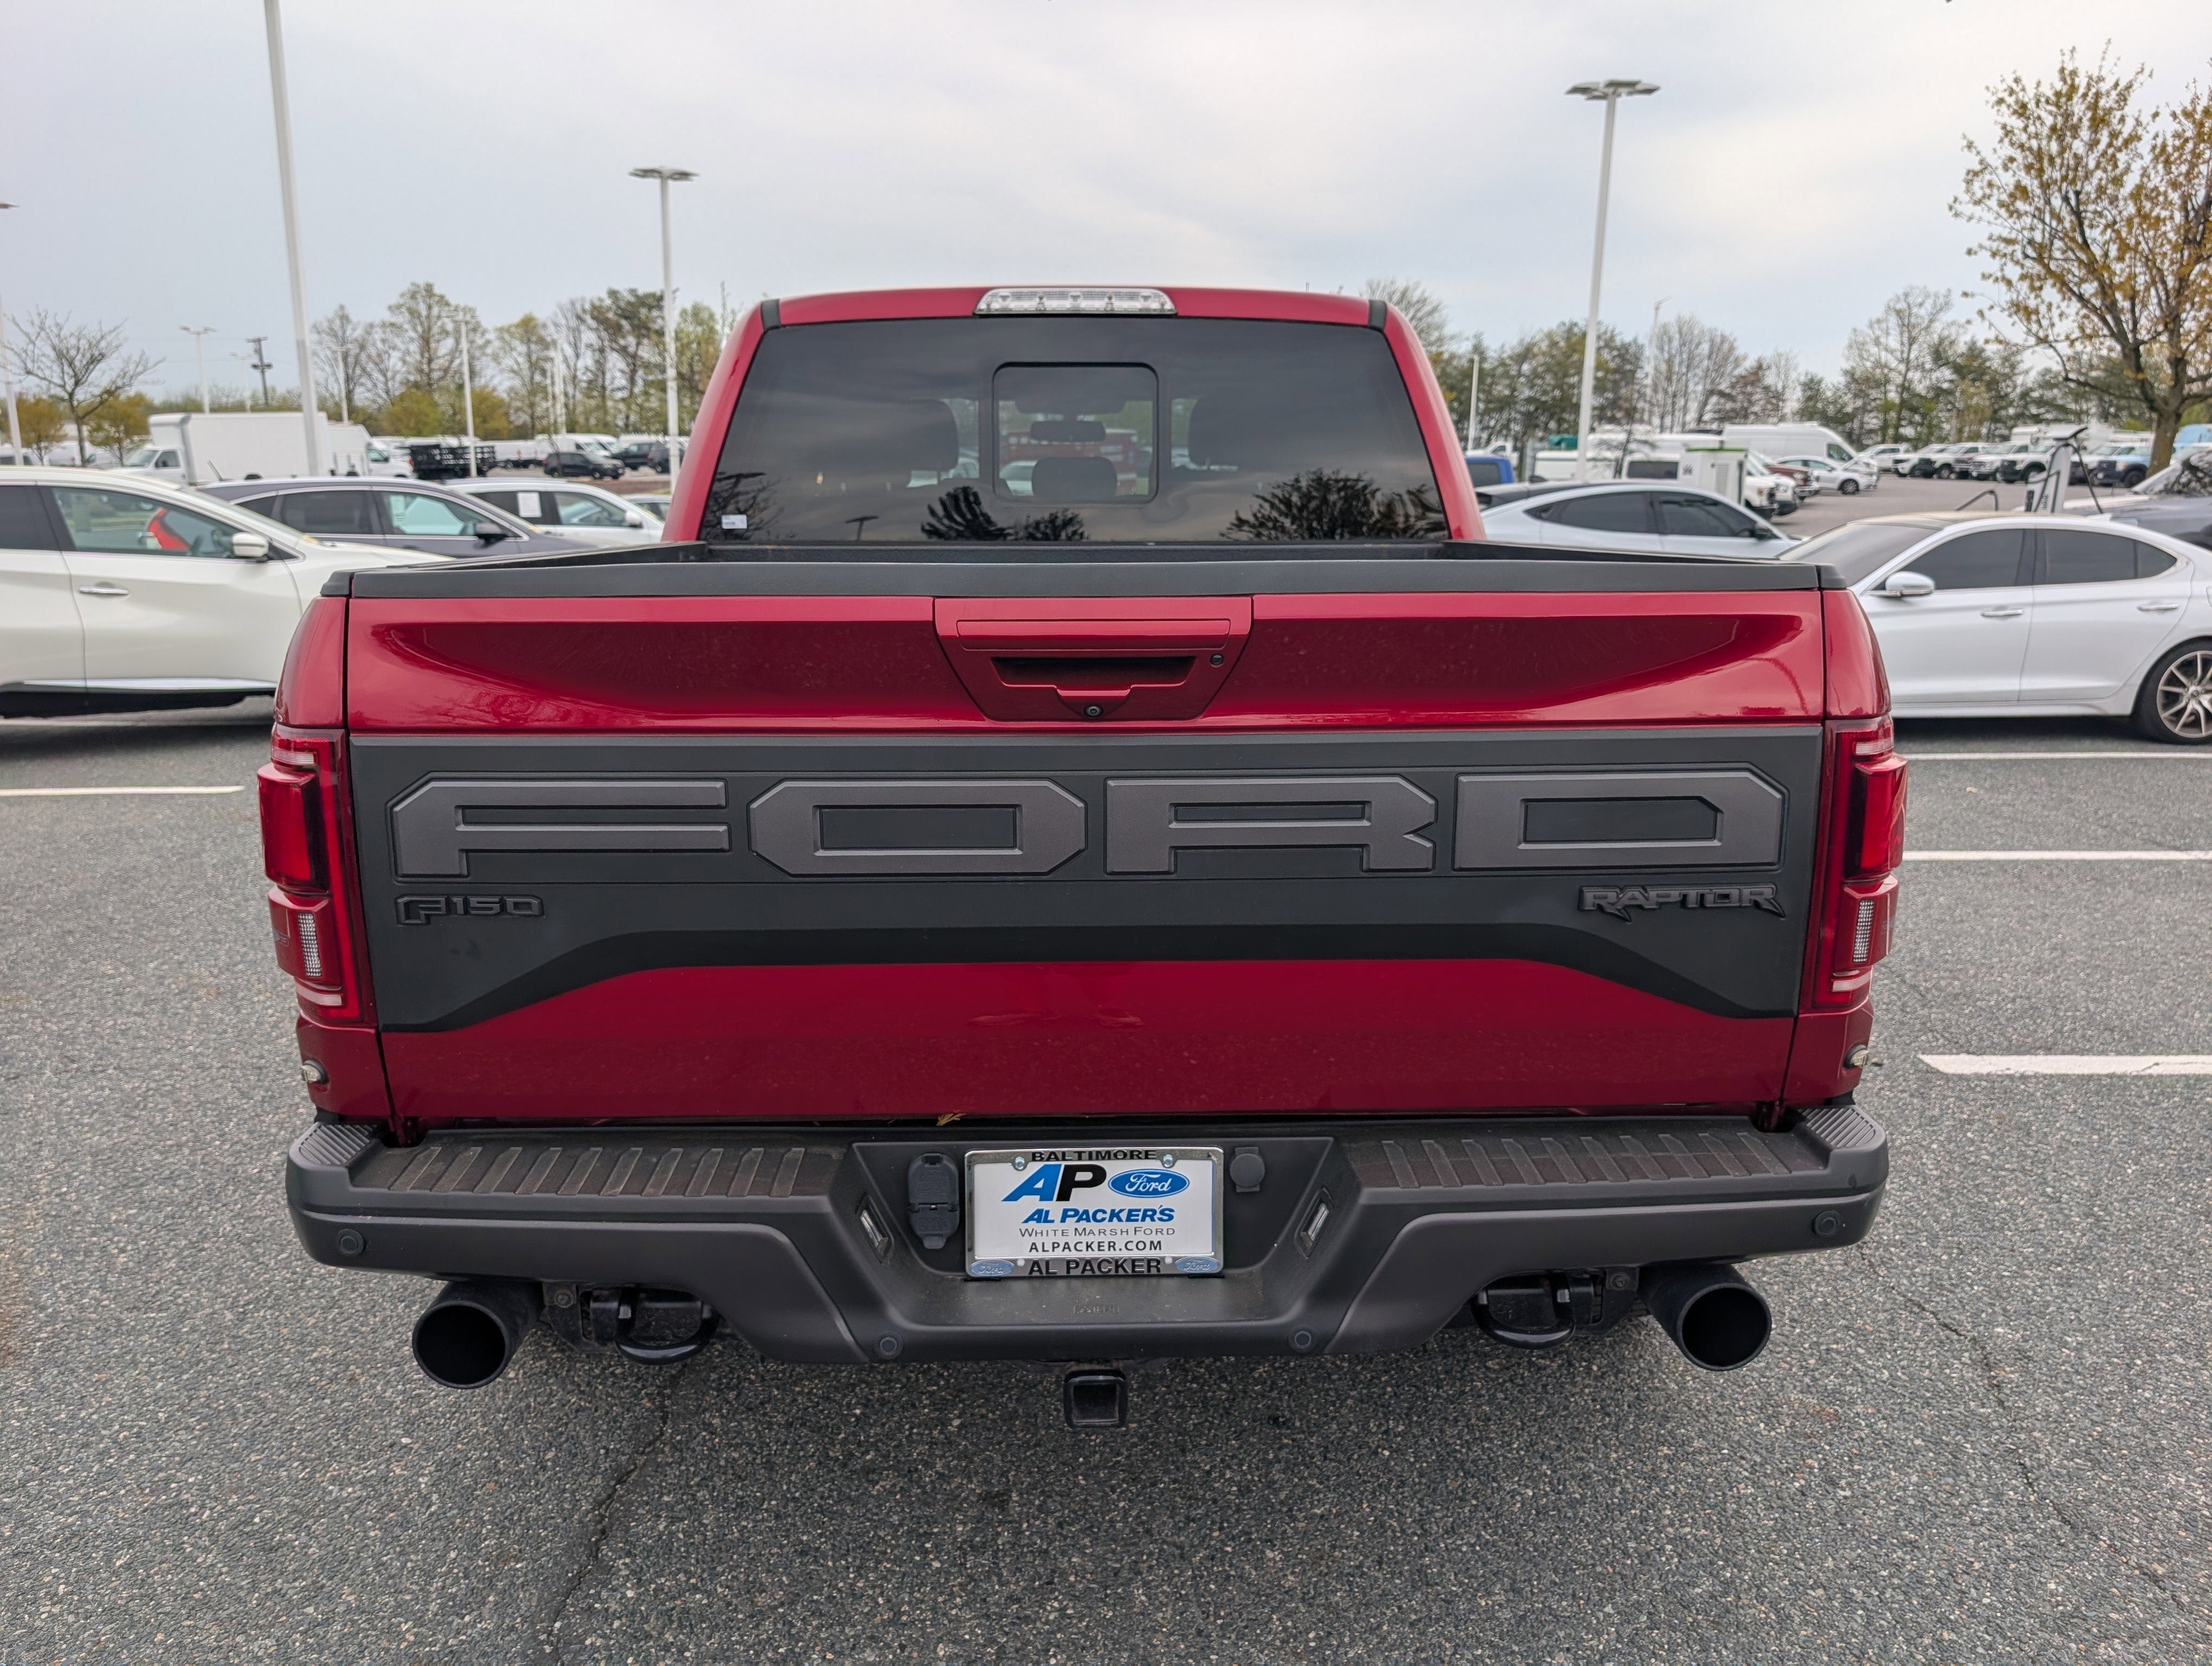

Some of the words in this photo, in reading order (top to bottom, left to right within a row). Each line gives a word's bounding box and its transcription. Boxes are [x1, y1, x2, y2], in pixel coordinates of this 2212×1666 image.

[390, 771, 1784, 875] FORD
[1578, 883, 1785, 921] RAPTOR
[1031, 1149, 1157, 1162] BALTIMORE
[1001, 1163, 1107, 1202] AP
[1125, 1173, 1172, 1192] Ford
[1021, 1208, 1055, 1223] AL
[1059, 1204, 1175, 1223] PACKER'S
[1028, 1240, 1162, 1253] ALPACKER.COM
[1028, 1259, 1058, 1275] AL
[1065, 1257, 1161, 1274] PACKER
